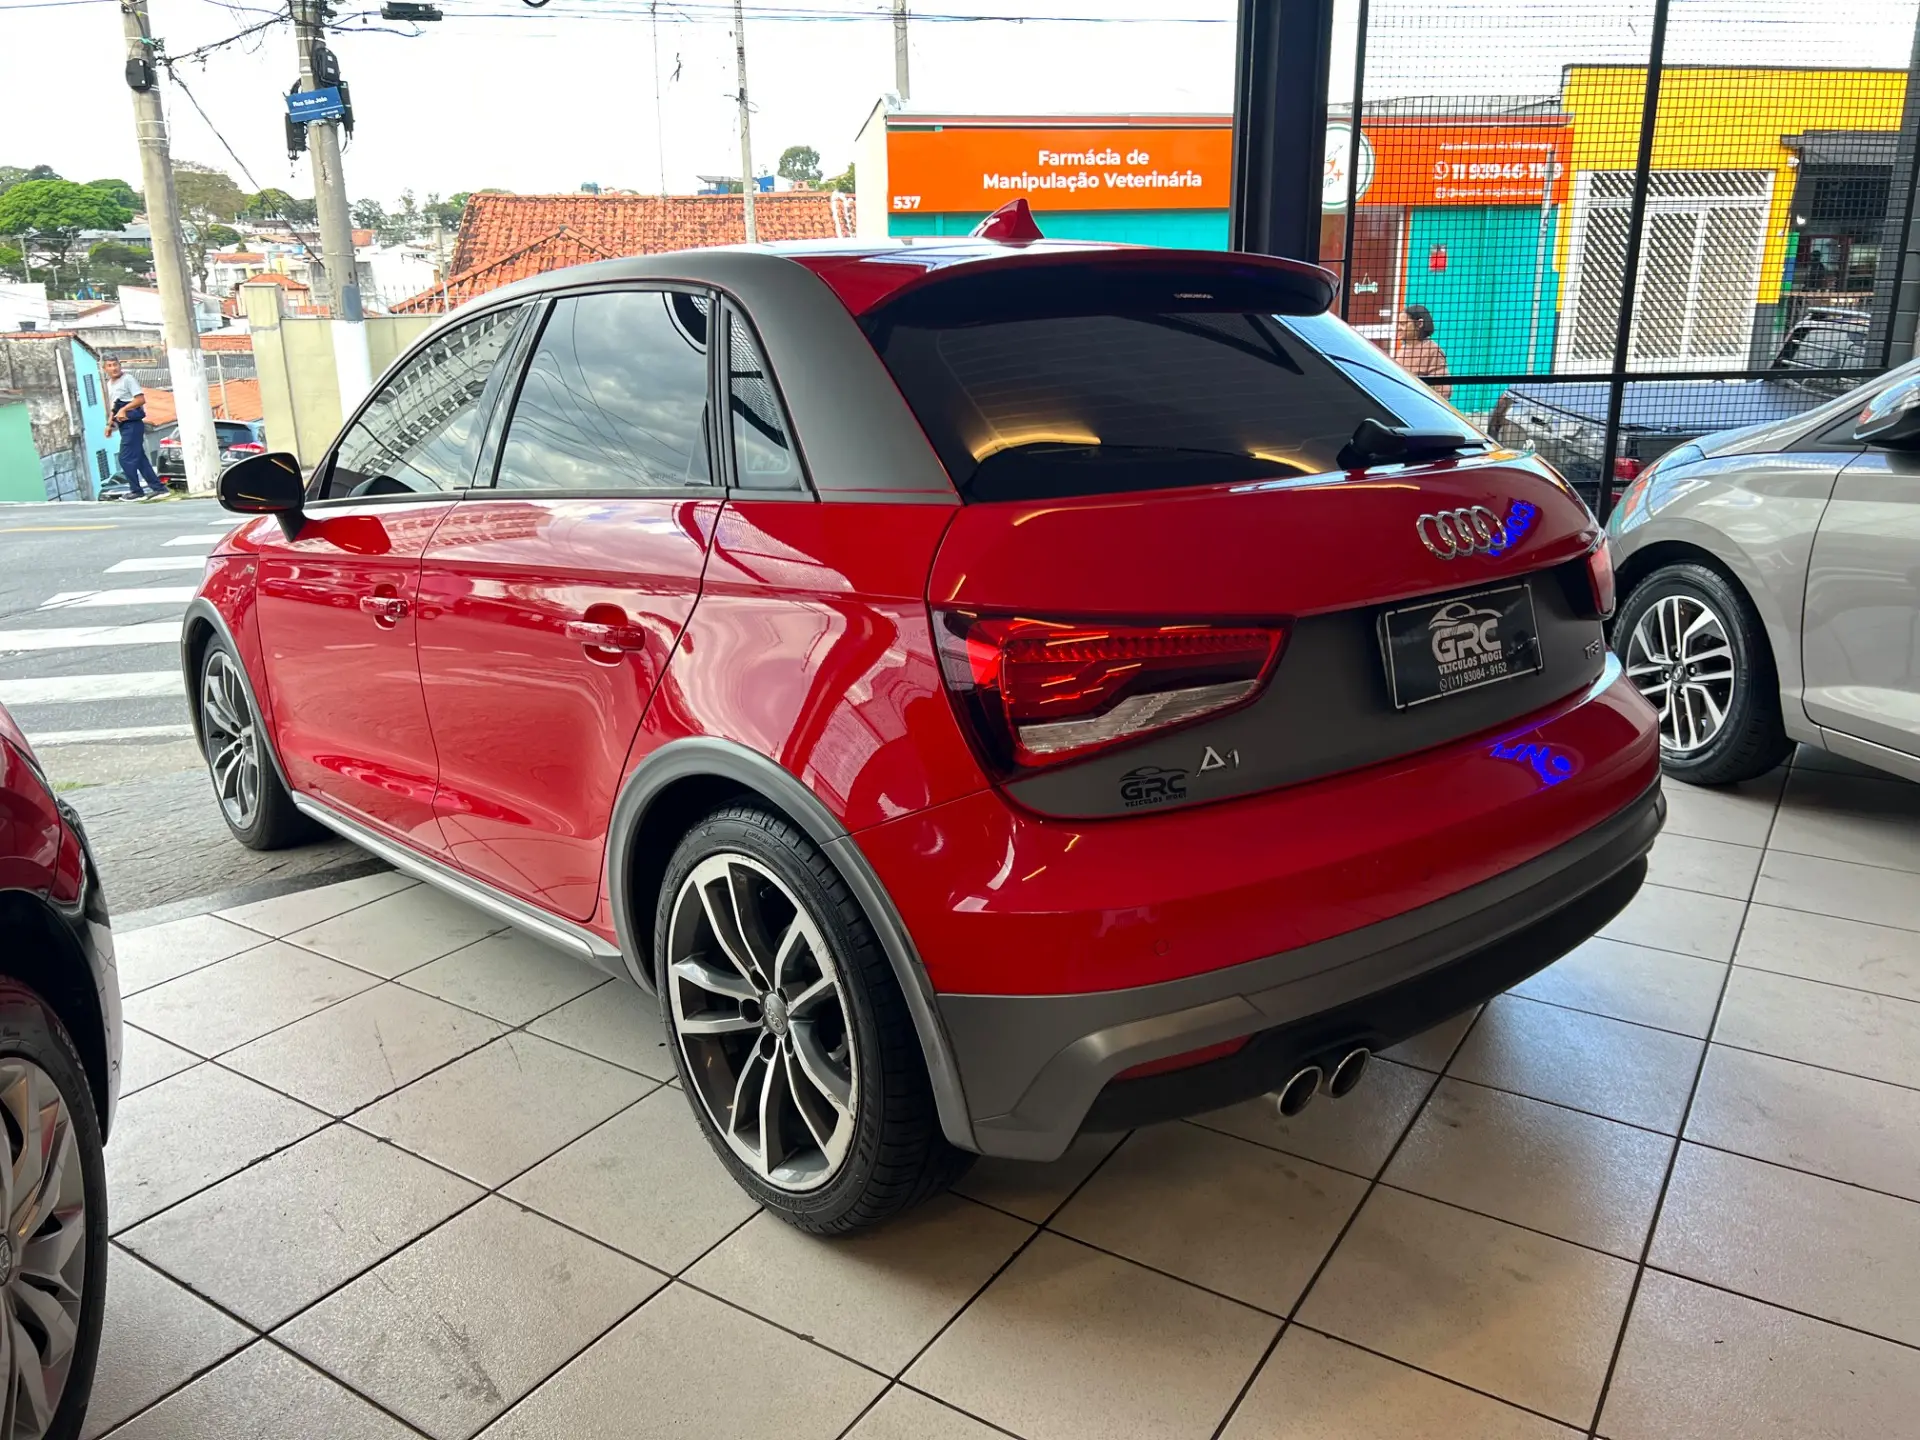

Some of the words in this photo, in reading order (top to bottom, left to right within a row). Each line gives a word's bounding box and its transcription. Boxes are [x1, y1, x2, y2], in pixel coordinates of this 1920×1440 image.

[1038, 148, 1121, 166] Farmácia
[1126, 148, 1149, 165] de
[983, 171, 1099, 192] Manipulação
[1104, 170, 1202, 188] Veterinária
[893, 195, 921, 209] 537
[1432, 618, 1502, 663] GRC
[1438, 656, 1478, 675] VEICULOS
[1480, 650, 1503, 664] MOGI
[1195, 745, 1240, 778] A1
[1121, 774, 1187, 801] GRC
